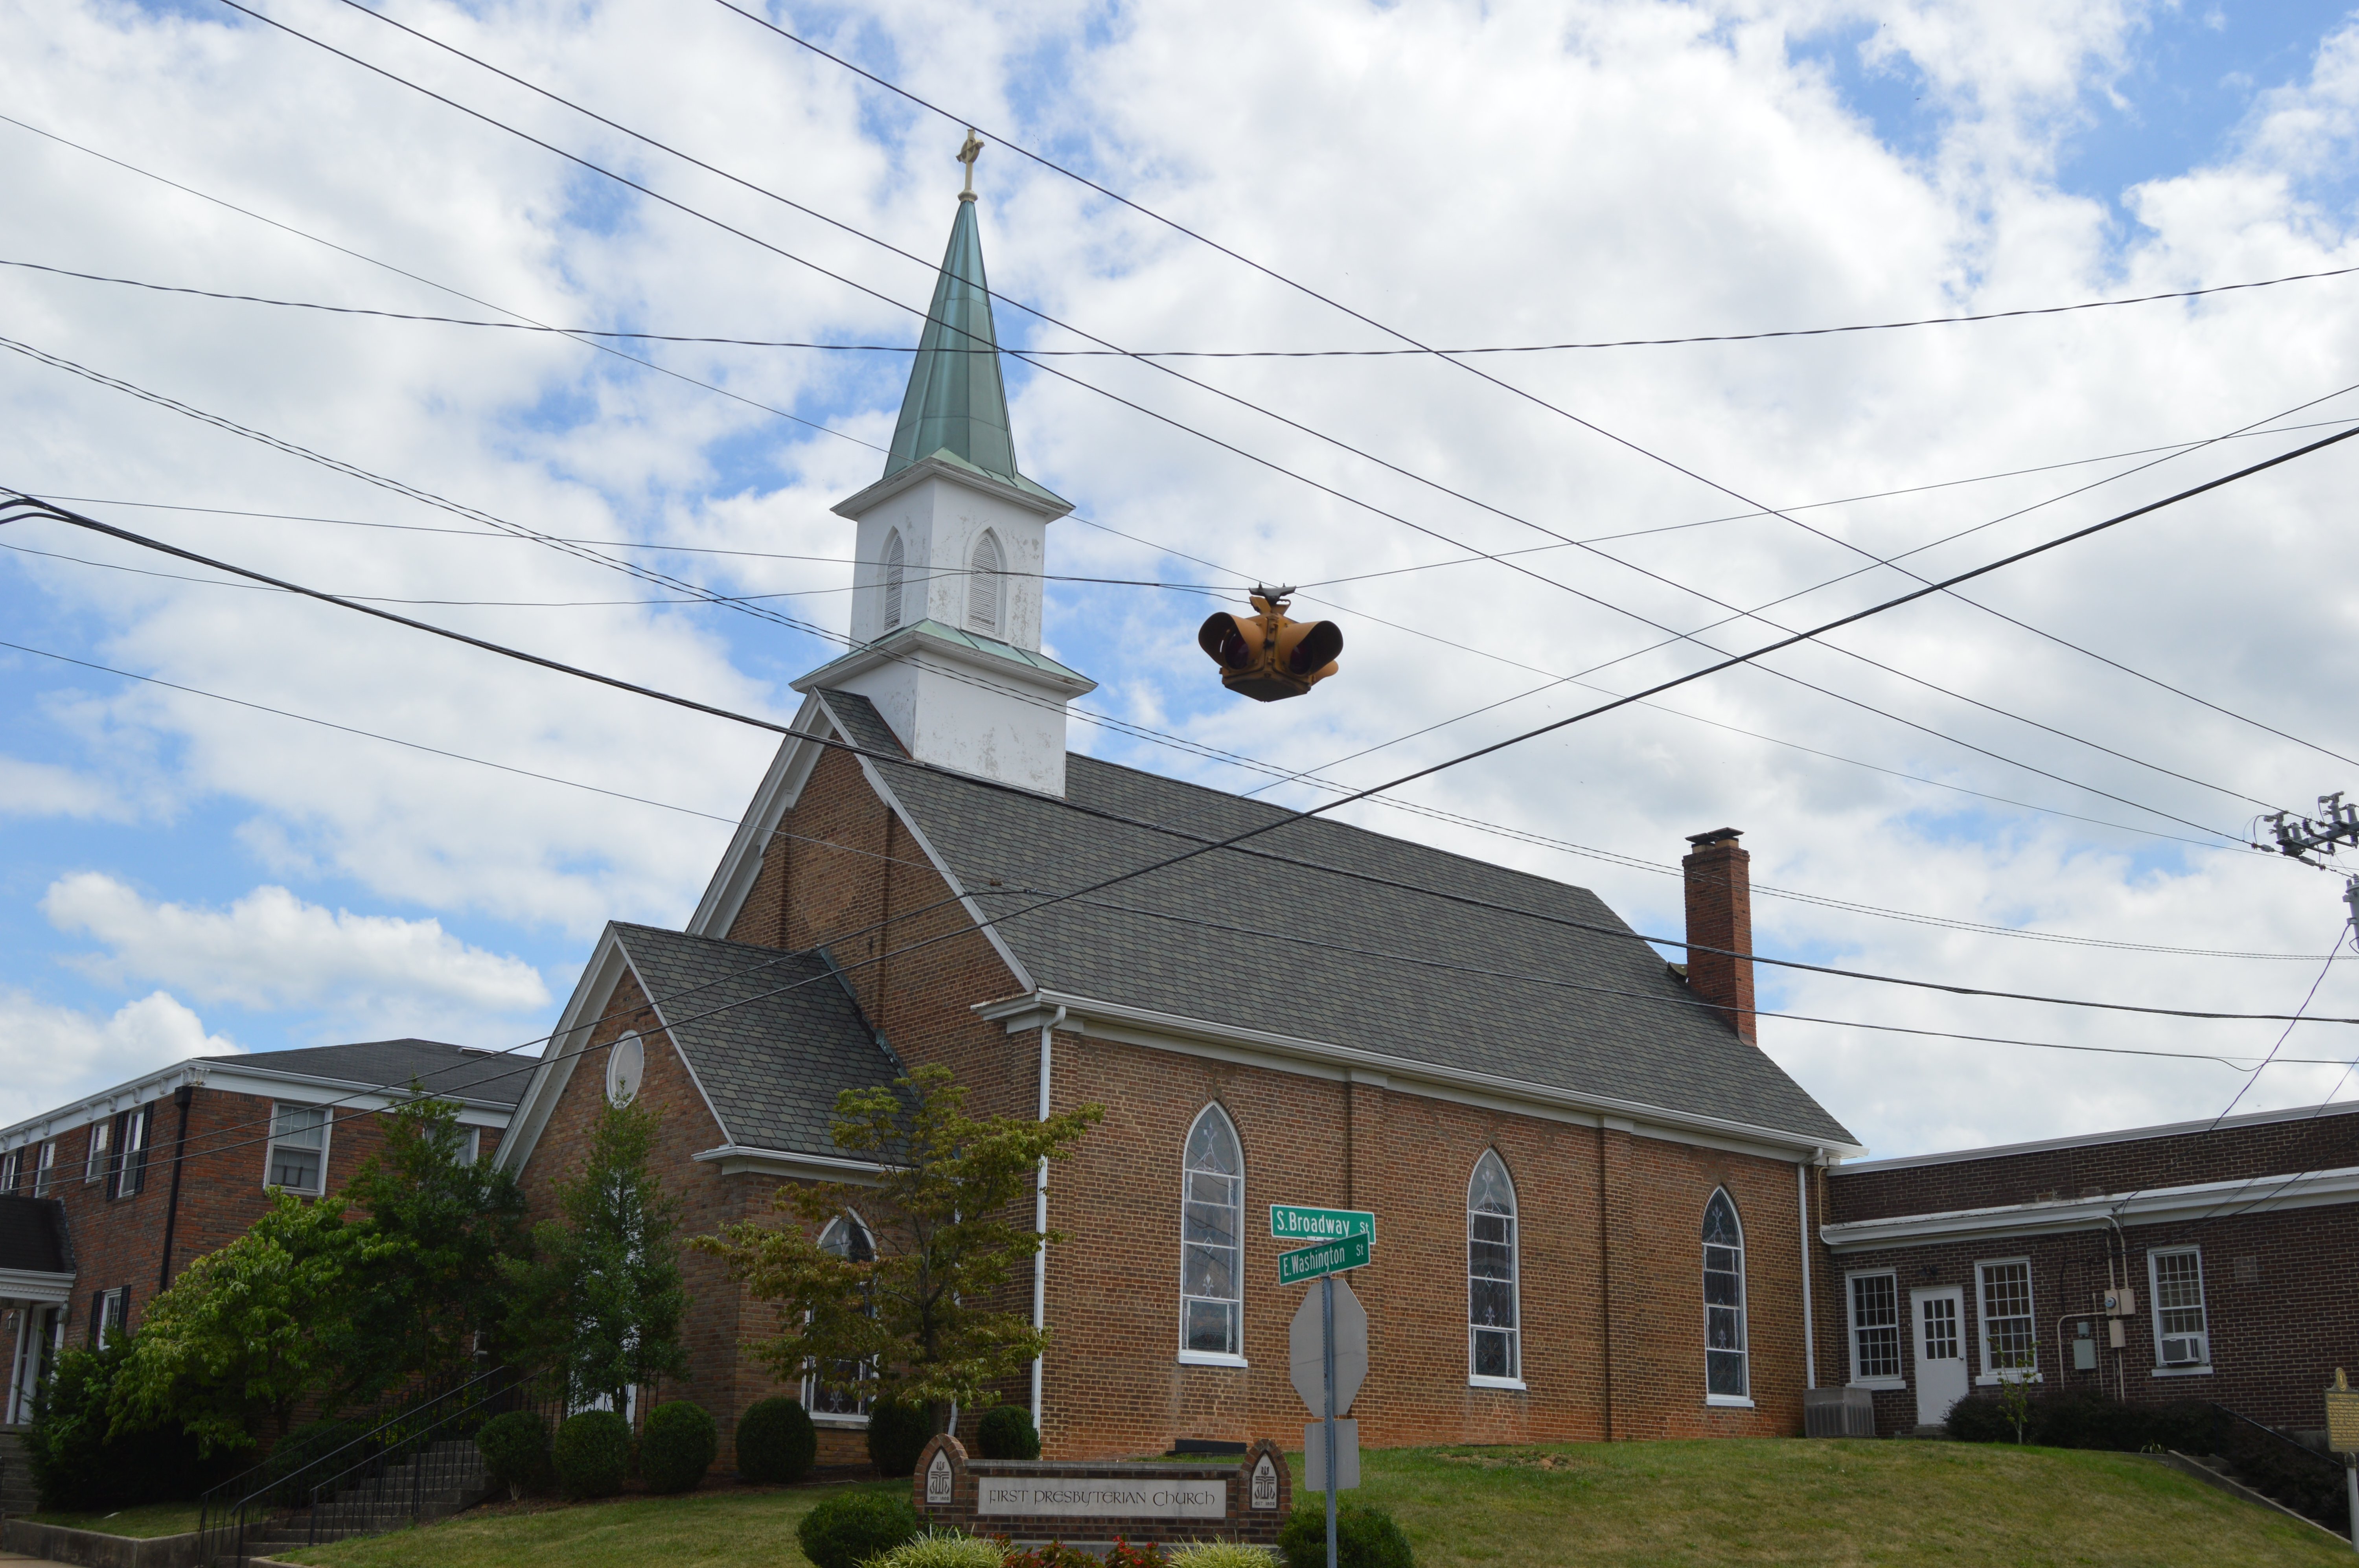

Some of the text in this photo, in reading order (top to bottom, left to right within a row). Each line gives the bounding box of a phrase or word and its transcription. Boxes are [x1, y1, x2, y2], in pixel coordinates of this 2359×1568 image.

[1360, 1221, 1369, 1233] St
[1356, 1244, 1364, 1256] St
[990, 1490, 1029, 1504] FIRST
[1034, 1491, 1146, 1507] PRESBYTERIAN
